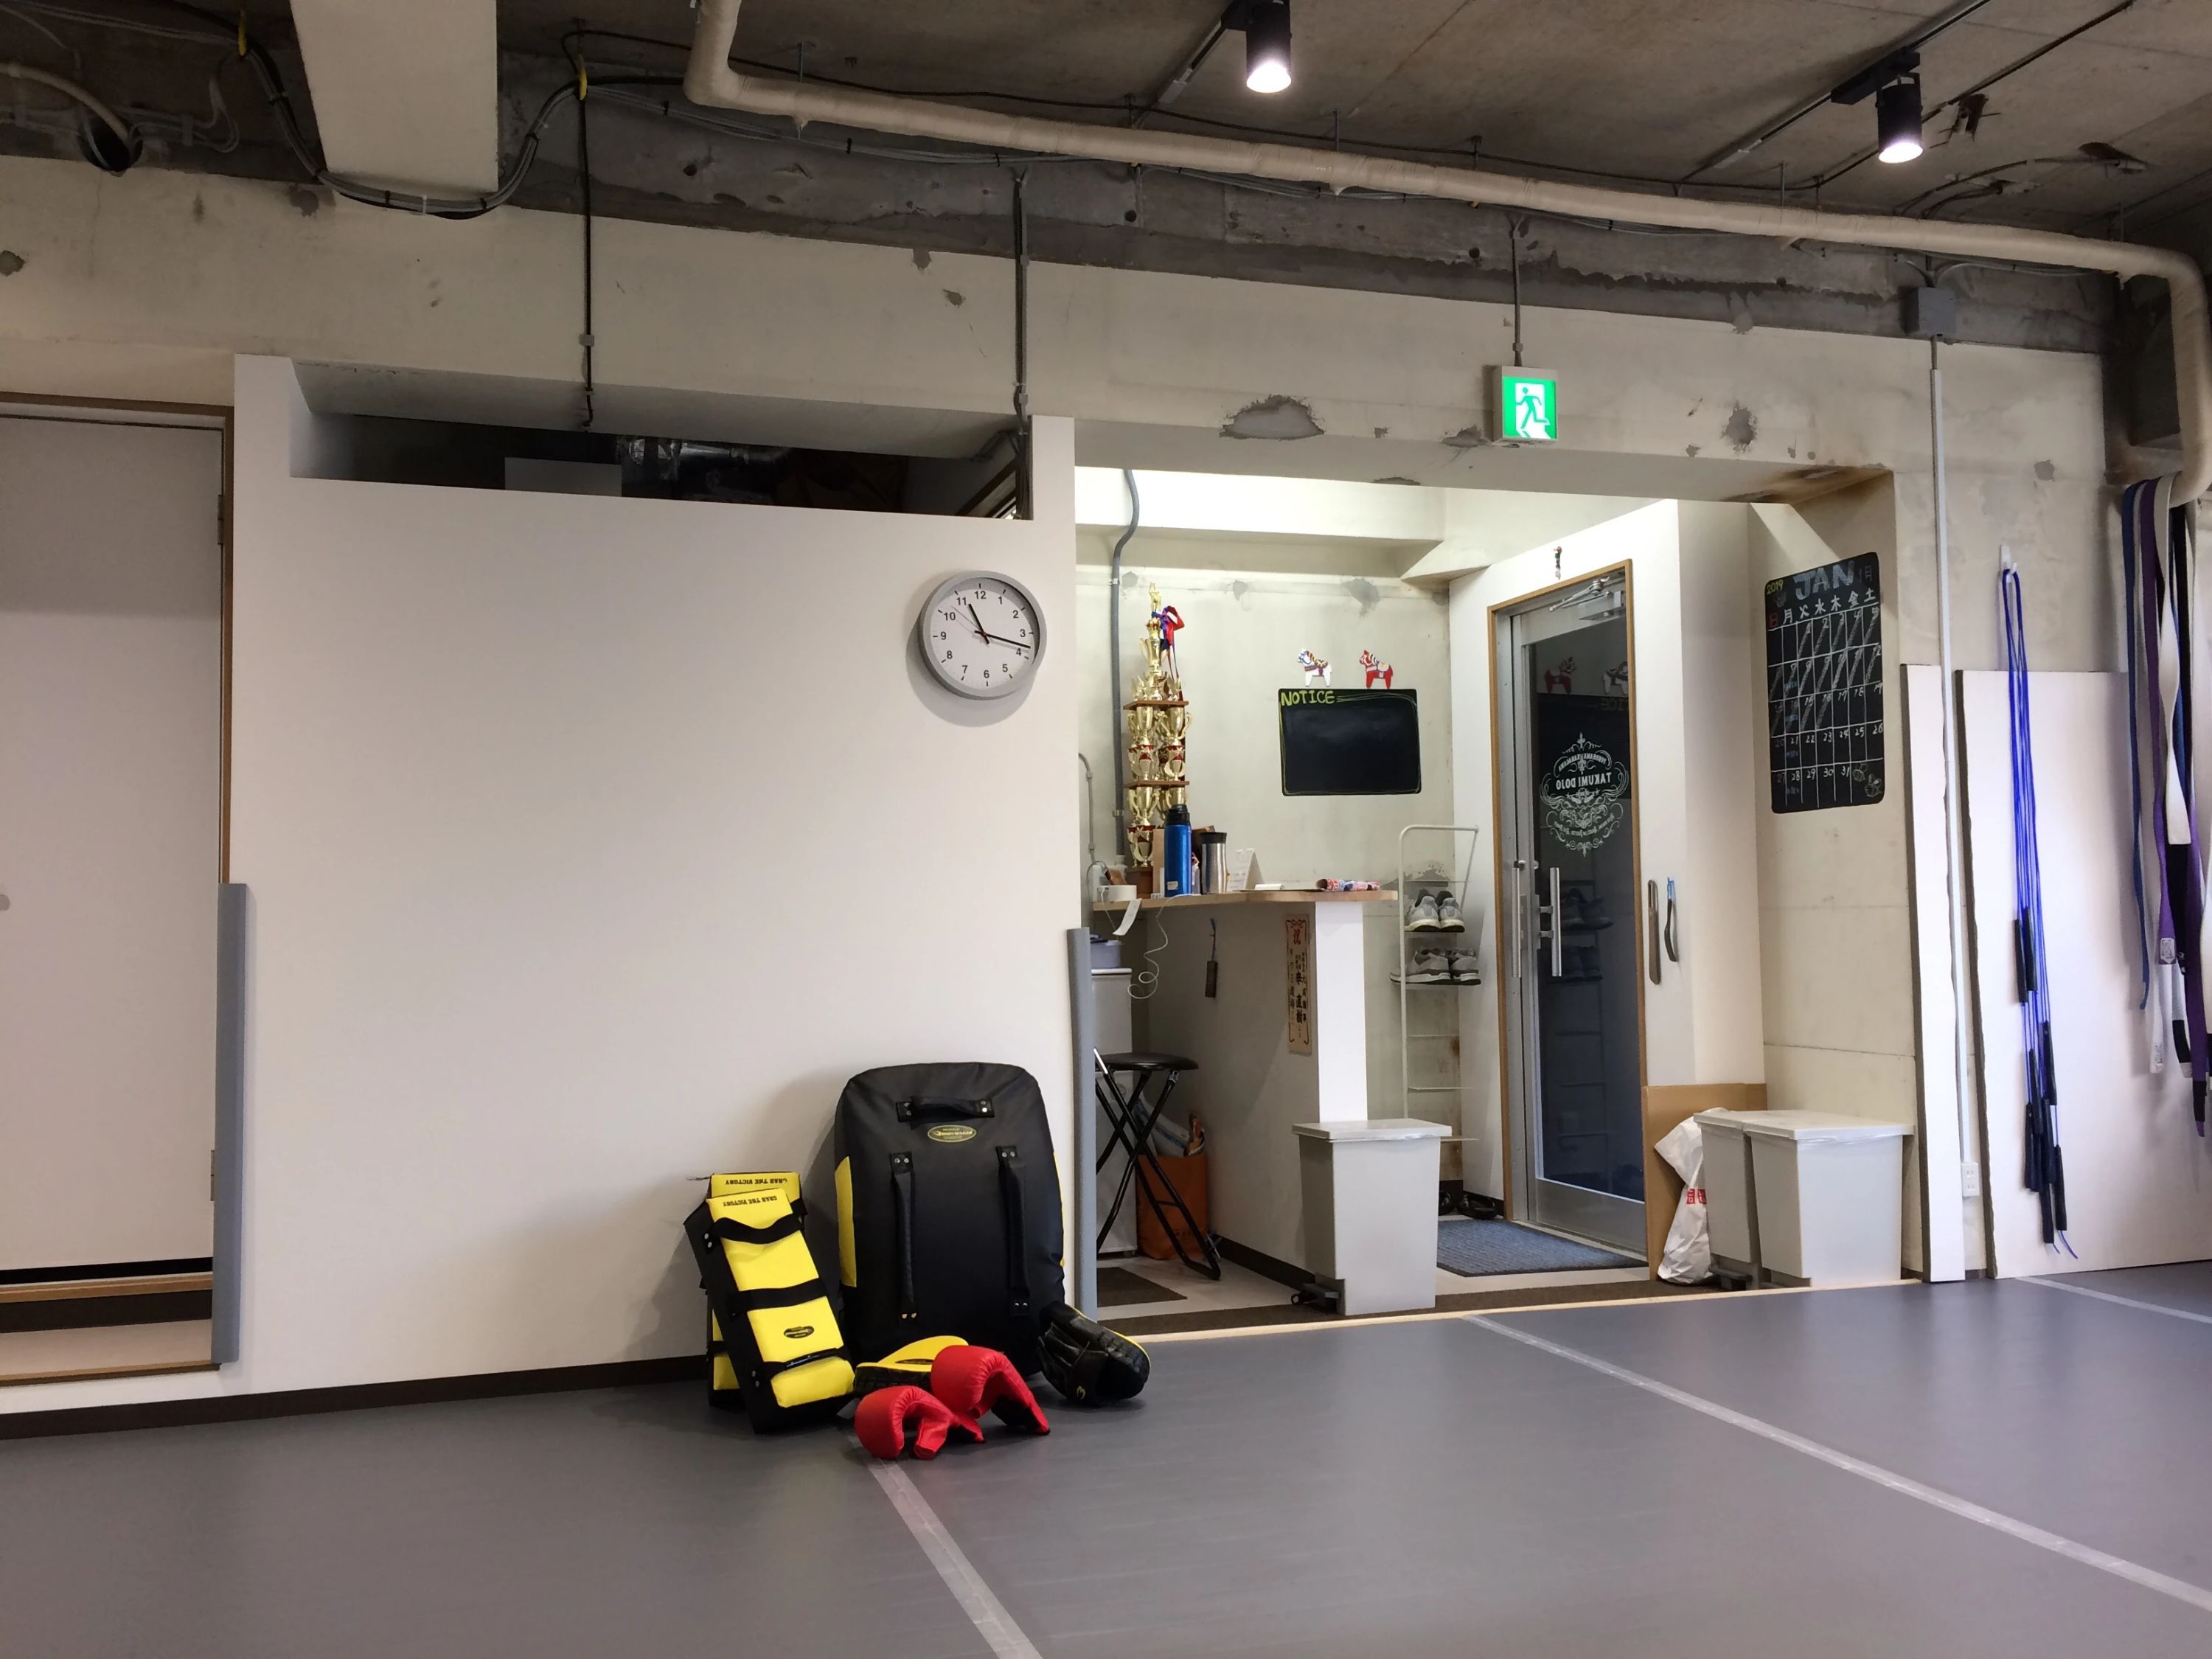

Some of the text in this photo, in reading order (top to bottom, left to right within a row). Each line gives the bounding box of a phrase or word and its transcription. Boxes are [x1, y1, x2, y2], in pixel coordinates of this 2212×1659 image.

[1793, 560, 1855, 600] JAN
[1767, 580, 1784, 595] 2019
[974, 591, 987, 599] 12
[956, 597, 967, 605] 11
[998, 596, 1003, 605] 1
[1783, 608, 1793, 625] 月
[1815, 598, 1826, 615] 水
[1831, 594, 1842, 611] 木
[1848, 590, 1859, 608] 金
[1864, 588, 1877, 602] 土
[944, 612, 956, 621] 10
[1012, 610, 1019, 619] 2
[1822, 617, 1829, 628] 2
[940, 631, 947, 640] 9
[1020, 629, 1026, 637] 3
[947, 650, 953, 659] 8
[1015, 648, 1022, 656] 4
[962, 665, 968, 673] 7
[1002, 664, 1009, 672] 5
[984, 670, 990, 678] 6
[1854, 687, 1864, 697] 18
[1281, 690, 1335, 706] NOTICE
[1790, 737, 1798, 745] 21
[1806, 735, 1815, 743] 22
[1823, 732, 1832, 742] 23
[1839, 729, 1848, 739] 24
[1855, 726, 1865, 737] 25
[1873, 723, 1883, 734] 26
[1792, 771, 1800, 781] 28
[1806, 768, 1815, 779] 29
[1823, 768, 1834, 777] 30
[1840, 766, 1850, 776] 31
[723, 1199, 748, 1207] VICTORY
